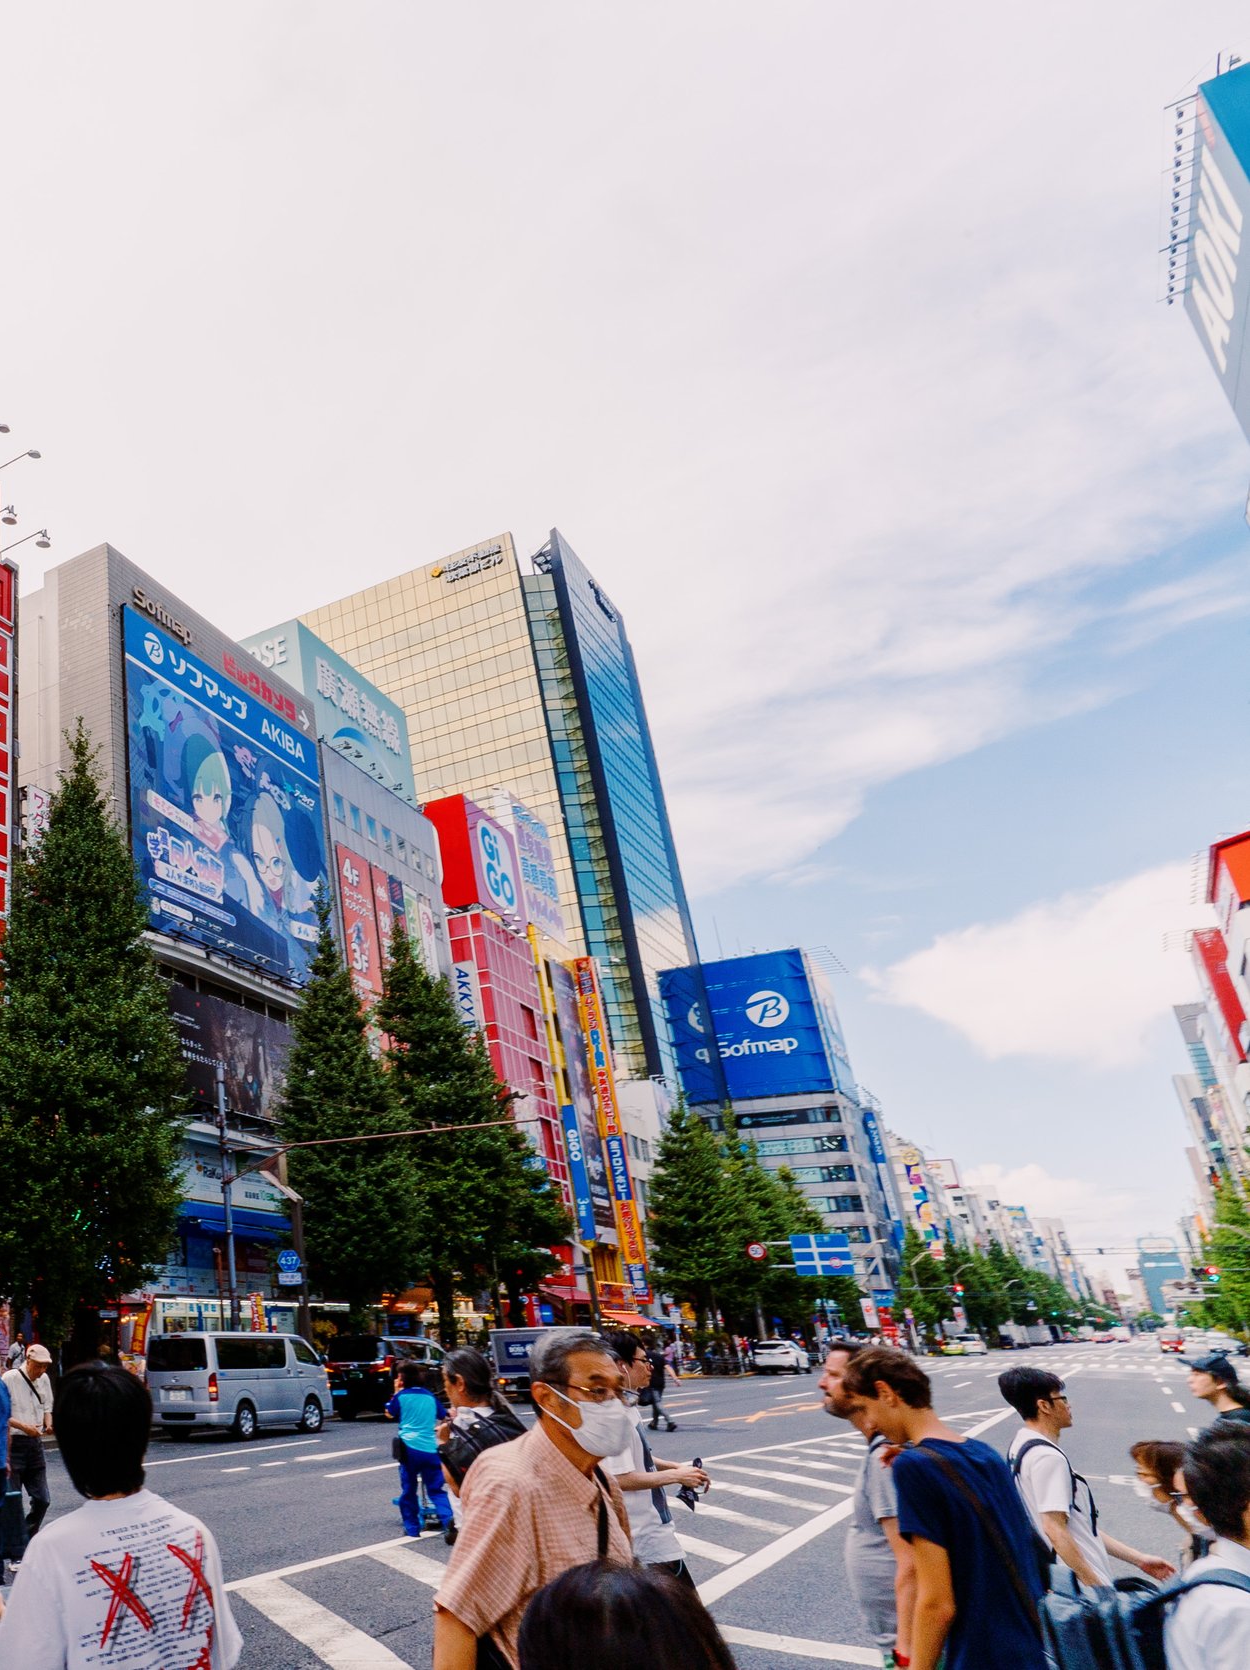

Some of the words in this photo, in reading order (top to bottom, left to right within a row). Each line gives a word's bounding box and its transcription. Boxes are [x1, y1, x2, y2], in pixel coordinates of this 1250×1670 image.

[132, 585, 193, 645] Sofmap
[168, 649, 248, 720] ソフマップ
[261, 717, 306, 764] AKIBA
[221, 650, 297, 722] ビックカメラ
[455, 967, 475, 1017] AKKY
[717, 1036, 799, 1060] Sofmap
[566, 1129, 582, 1162] GiGO
[280, 1256, 298, 1265] 437
